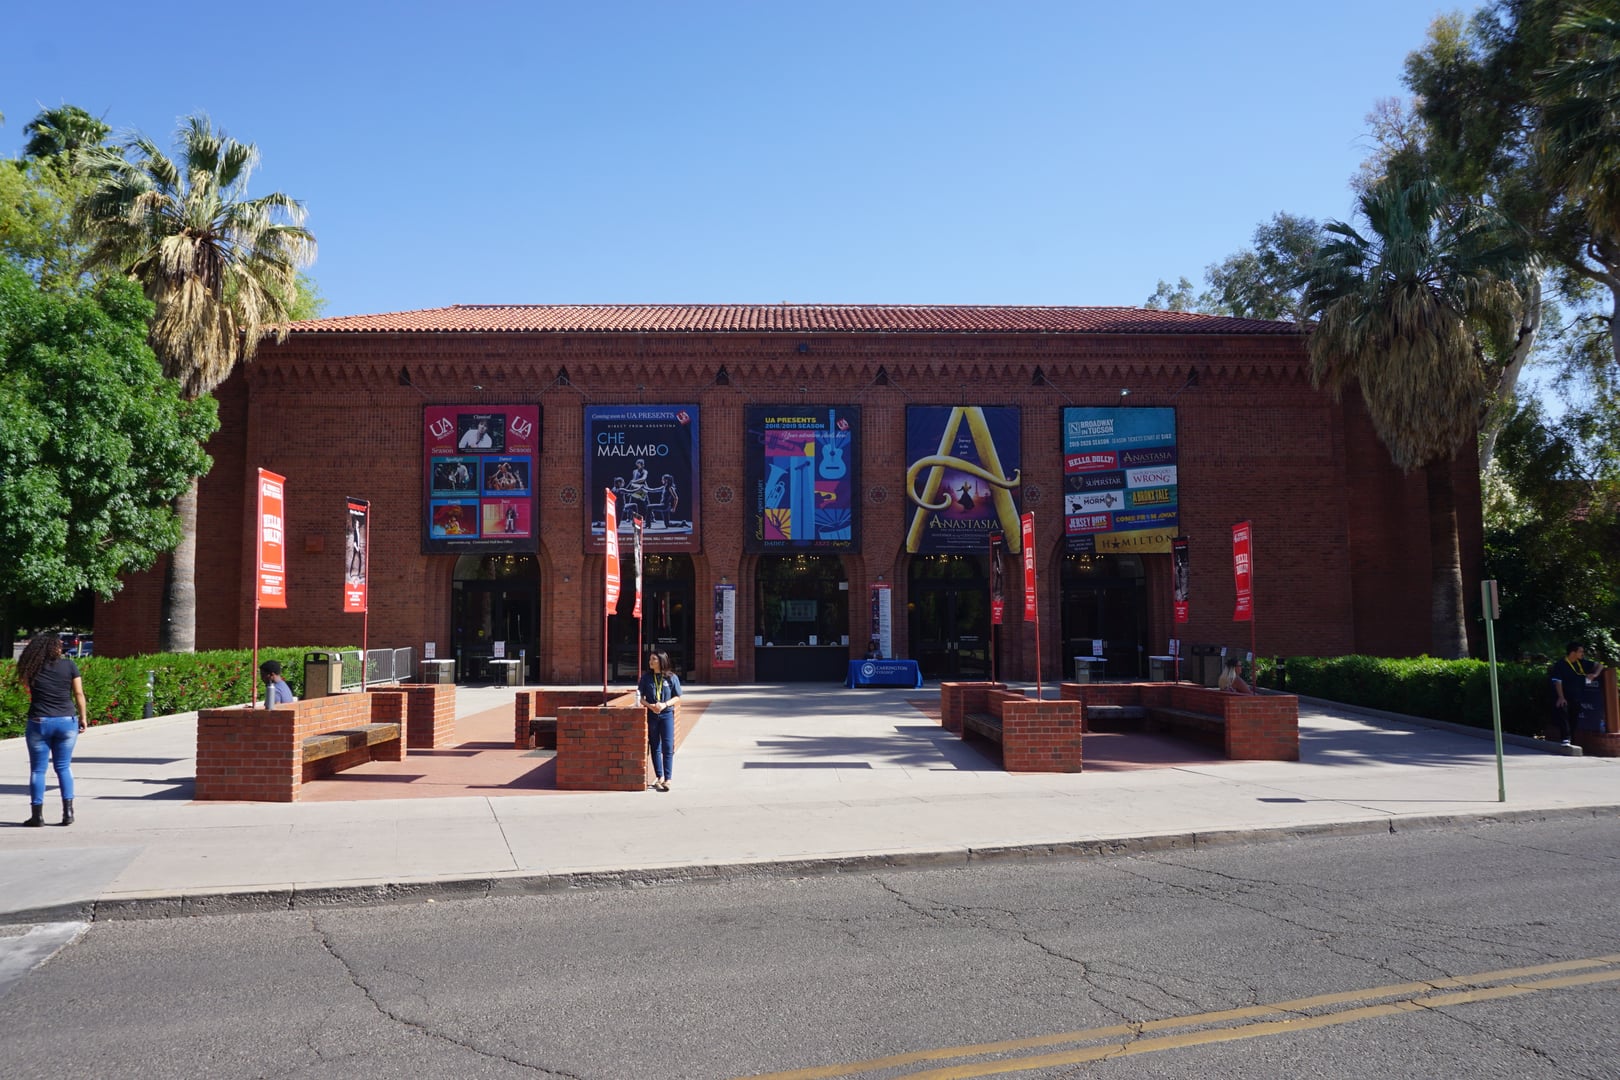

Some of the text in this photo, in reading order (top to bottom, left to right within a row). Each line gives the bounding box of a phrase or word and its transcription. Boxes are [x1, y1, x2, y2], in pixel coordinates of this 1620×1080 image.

[429, 417, 454, 437] UA
[511, 416, 532, 438] UA
[1081, 419, 1114, 428] BROADWAY
[1088, 426, 1114, 434] TUCSON
[597, 432, 625, 445] CHE
[597, 443, 669, 457] MALAMBO
[1132, 474, 1170, 484] WRONG
[930, 514, 999, 528] ANASTASIA
